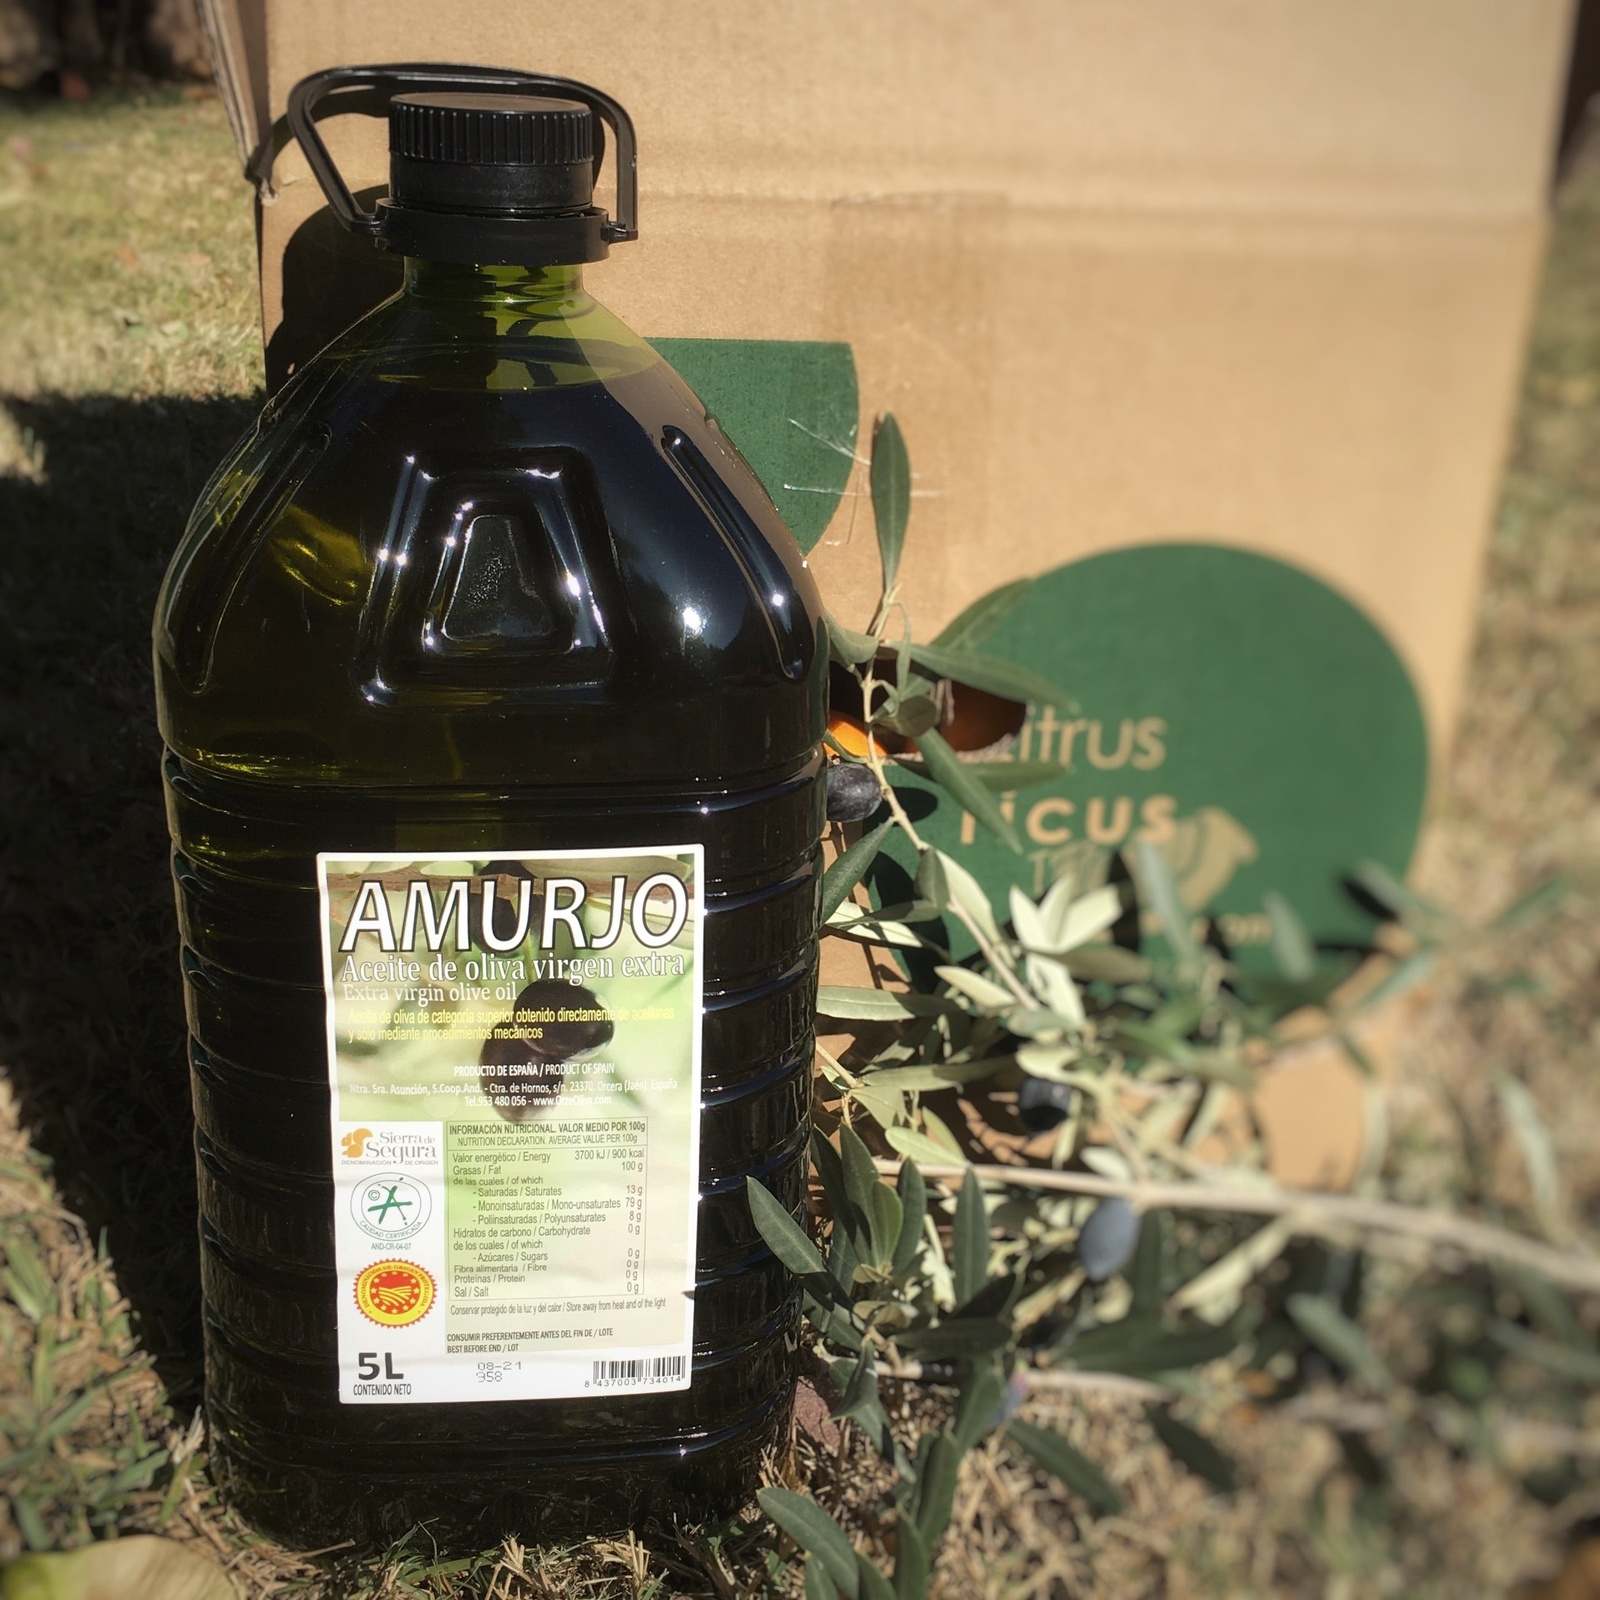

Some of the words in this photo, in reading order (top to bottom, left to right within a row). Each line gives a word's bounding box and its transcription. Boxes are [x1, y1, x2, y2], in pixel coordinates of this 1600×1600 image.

[985, 704, 1167, 770] itrus
[338, 872, 688, 952] AMURJO
[342, 955, 421, 982] Aceite
[429, 953, 457, 981] de
[465, 953, 526, 981] oliva
[533, 952, 614, 986] virgen
[621, 951, 684, 978] extra
[344, 984, 389, 1000] Extra
[394, 983, 445, 1007] virgin
[450, 982, 491, 1000] olive
[495, 981, 518, 1000] oil
[394, 1009, 415, 1024] oliva
[418, 1009, 429, 1024] de
[477, 1008, 514, 1026] superior
[516, 1007, 555, 1023] obtenido
[558, 1007, 616, 1022] directamente
[349, 1029, 355, 1043] y
[378, 1026, 421, 1040] mediante
[495, 1025, 543, 1039] mecánicos
[454, 1065, 496, 1077] PRODUCTO
[497, 1065, 508, 1076] DE
[509, 1062, 538, 1076] ESPAÑA
[545, 1063, 581, 1075] PRODUCT
[582, 1063, 592, 1074] OF
[593, 1063, 615, 1074] SPAIN
[489, 1083, 508, 1094] Ctra.
[509, 1082, 520, 1093] de
[521, 1082, 551, 1095] Hornos,
[494, 1096, 510, 1106] 480
[512, 1095, 526, 1106] 056
[449, 1124, 502, 1135] INFORMACIÓN
[559, 1123, 584, 1133] VALOR
[585, 1122, 610, 1132] MEDIO
[611, 1122, 627, 1131] POR
[629, 1121, 646, 1133] 100g
[380, 1132, 421, 1144] Sierra
[457, 1137, 495, 1146] NUTRITION
[549, 1135, 581, 1144] AVERAGE
[583, 1134, 605, 1144] VALUE
[606, 1134, 621, 1143] PER
[622, 1133, 638, 1144] 100g
[366, 1141, 436, 1163] Segura
[453, 1152, 473, 1163] Valor
[523, 1151, 551, 1164] Energy
[575, 1150, 594, 1160] 3700
[596, 1149, 606, 1160] kJ
[612, 1149, 627, 1159] 900
[629, 1148, 645, 1158] kcal
[453, 1165, 482, 1175] Grasas
[488, 1165, 502, 1175] Fat
[622, 1161, 636, 1171] 100
[638, 1163, 644, 1172] g
[453, 1177, 464, 1185] de
[479, 1177, 505, 1186] cuales
[511, 1176, 519, 1185] of
[520, 1176, 544, 1185] which
[478, 1187, 518, 1197] Saturadas
[525, 1186, 562, 1197] Saturates
[626, 1184, 636, 1194] 13
[637, 1186, 643, 1196] g
[478, 1200, 545, 1212] Monoinsaturadas
[552, 1199, 621, 1210] Mono-unsaturates
[625, 1197, 635, 1208] 79
[637, 1199, 642, 1210] g
[544, 1213, 606, 1225] Polyunsaturates
[636, 1212, 642, 1223] g
[453, 1228, 486, 1238] Hidratos
[488, 1228, 498, 1237] de
[500, 1227, 532, 1237] carbono
[538, 1226, 591, 1238] Carbohydrate
[635, 1225, 640, 1235] g
[453, 1241, 463, 1250] de
[465, 1241, 477, 1250] los
[479, 1240, 505, 1250] cuales
[511, 1240, 519, 1249] of
[520, 1239, 543, 1249] which
[478, 1252, 514, 1262] Azúcares
[520, 1251, 549, 1263] Sugars
[635, 1249, 640, 1259] g
[454, 1265, 474, 1273] Fibra
[476, 1264, 518, 1273] alimentaria
[527, 1263, 547, 1271] Fibre
[634, 1261, 639, 1269] g
[498, 1274, 525, 1282] Protein
[633, 1271, 638, 1281] g
[454, 1286, 467, 1297] Sal
[474, 1286, 489, 1297] Salt
[634, 1283, 639, 1295] g
[450, 1305, 480, 1315] Conservar
[481, 1304, 507, 1316] protegido
[509, 1304, 516, 1314] de
[517, 1304, 523, 1313] la
[524, 1303, 532, 1313] luz
[538, 1303, 547, 1313] del
[547, 1303, 562, 1312] calor
[567, 1301, 581, 1312] Store
[583, 1303, 597, 1313] away
[599, 1301, 612, 1310] from
[612, 1300, 625, 1310] heat
[626, 1300, 634, 1309] and
[635, 1299, 642, 1309] of
[644, 1298, 653, 1308] the
[654, 1298, 666, 1310] light
[447, 1333, 480, 1342] CONSUMIR
[482, 1331, 539, 1341] PREFERENTEMENTE
[540, 1330, 560, 1339] ANTES
[561, 1330, 572, 1338] DEL
[573, 1329, 583, 1337] FIN
[584, 1329, 593, 1337] DE
[599, 1328, 614, 1336] LOTE
[447, 1345, 462, 1353] BEST
[464, 1344, 487, 1353] BEFORE
[489, 1344, 502, 1352] END
[507, 1344, 519, 1352] LOT
[358, 1352, 404, 1381] 5L
[477, 1361, 522, 1371] 08-21
[353, 1384, 392, 1396] CONTENIDO
[394, 1383, 412, 1395] NETO
